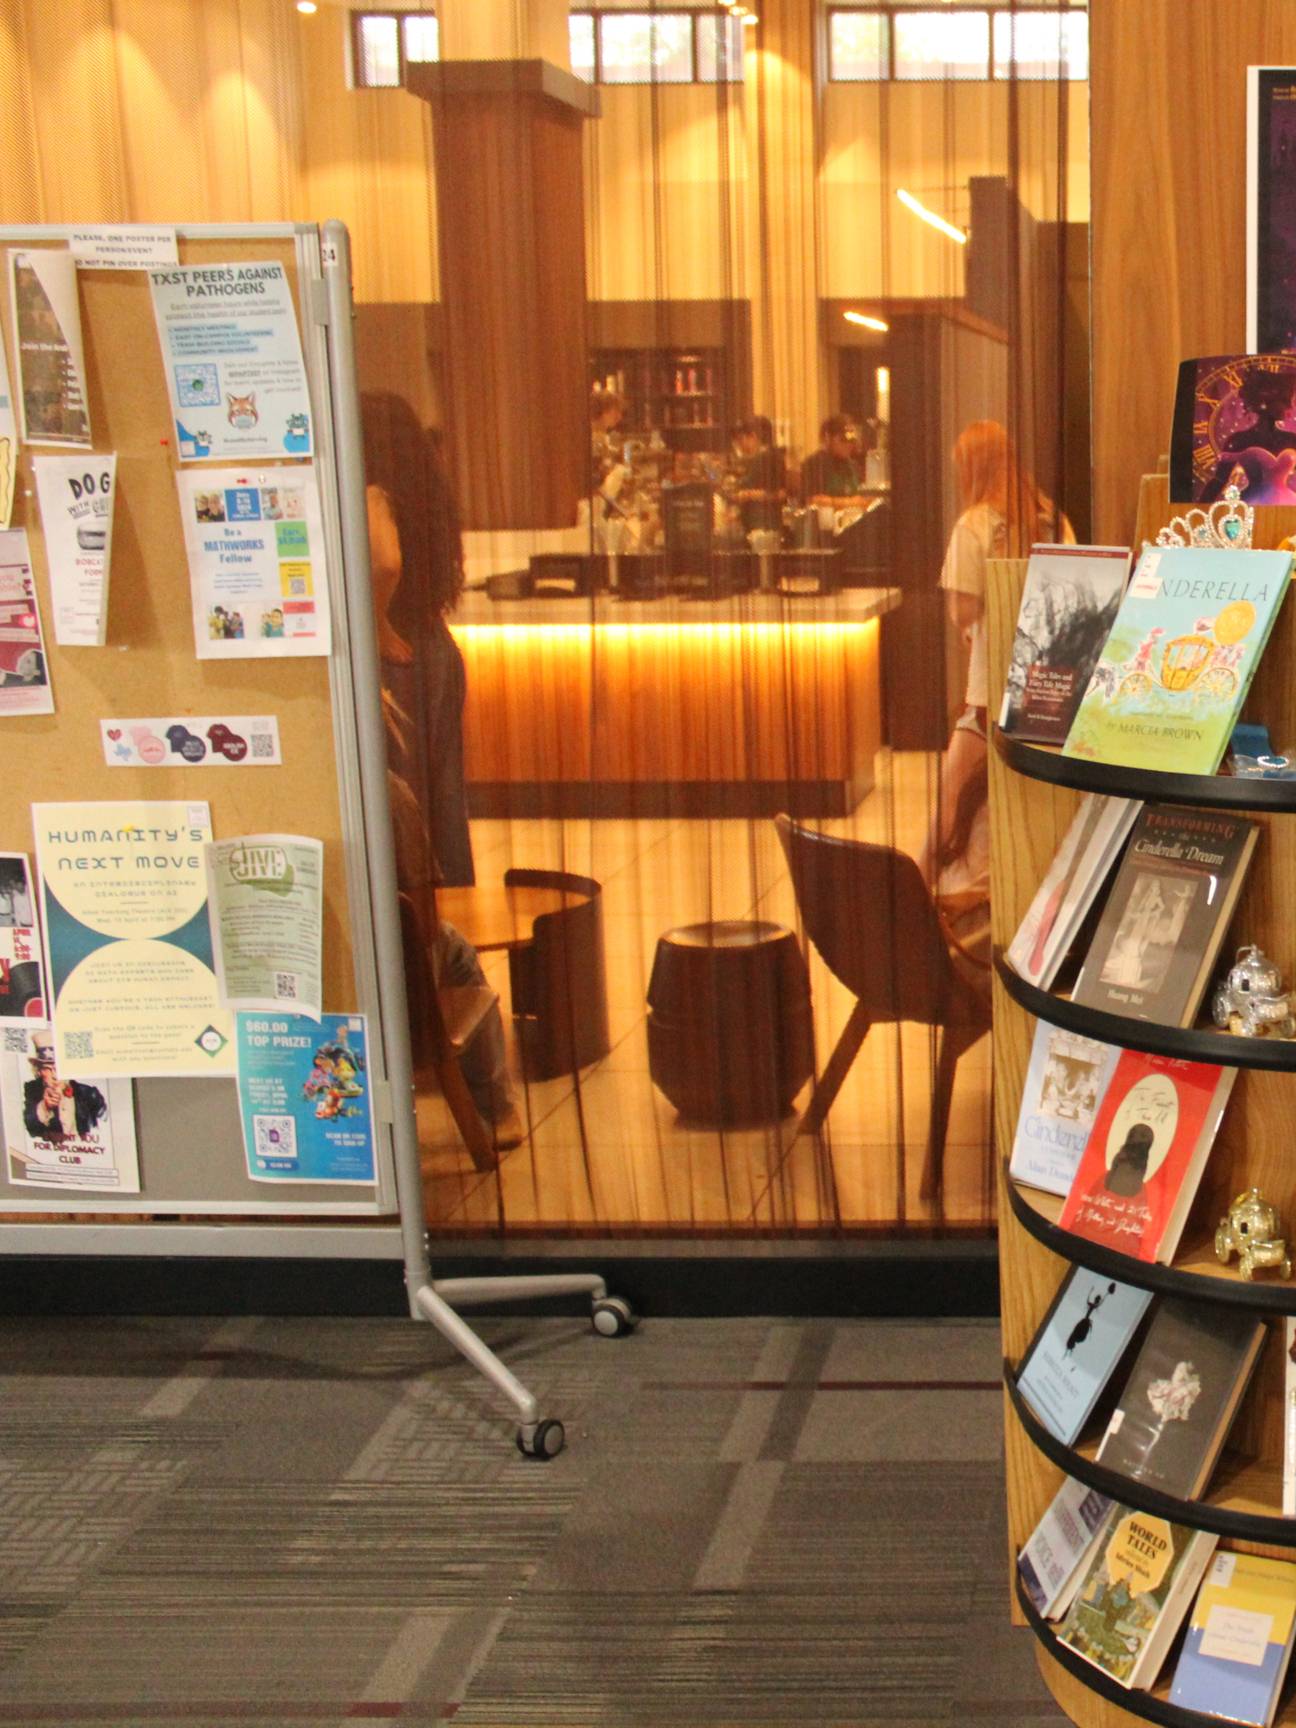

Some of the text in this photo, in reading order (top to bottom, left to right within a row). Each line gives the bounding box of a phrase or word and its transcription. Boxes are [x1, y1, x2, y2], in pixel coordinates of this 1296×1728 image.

[151, 267, 283, 286] TXST PEERS AGAINST
[186, 281, 265, 298] PATHOGENS
[204, 539, 265, 552] MATHWORKS
[219, 553, 253, 563] Fellow
[1160, 578, 1268, 602] NDERELLA
[1161, 727, 1203, 741] BROWN
[48, 826, 204, 843] HUMANITY'S
[1134, 838, 1225, 866] Cinderella Dream
[58, 856, 200, 870] NEXT MOVE
[248, 1035, 311, 1049] TOP PRIZE!
[80, 1134, 99, 1143] YOU
[34, 1142, 105, 1155] FOR DIPLOMACY
[59, 1155, 81, 1165] CLUB
[1129, 1520, 1168, 1552] WORLD
[1127, 1533, 1157, 1560] TALES
